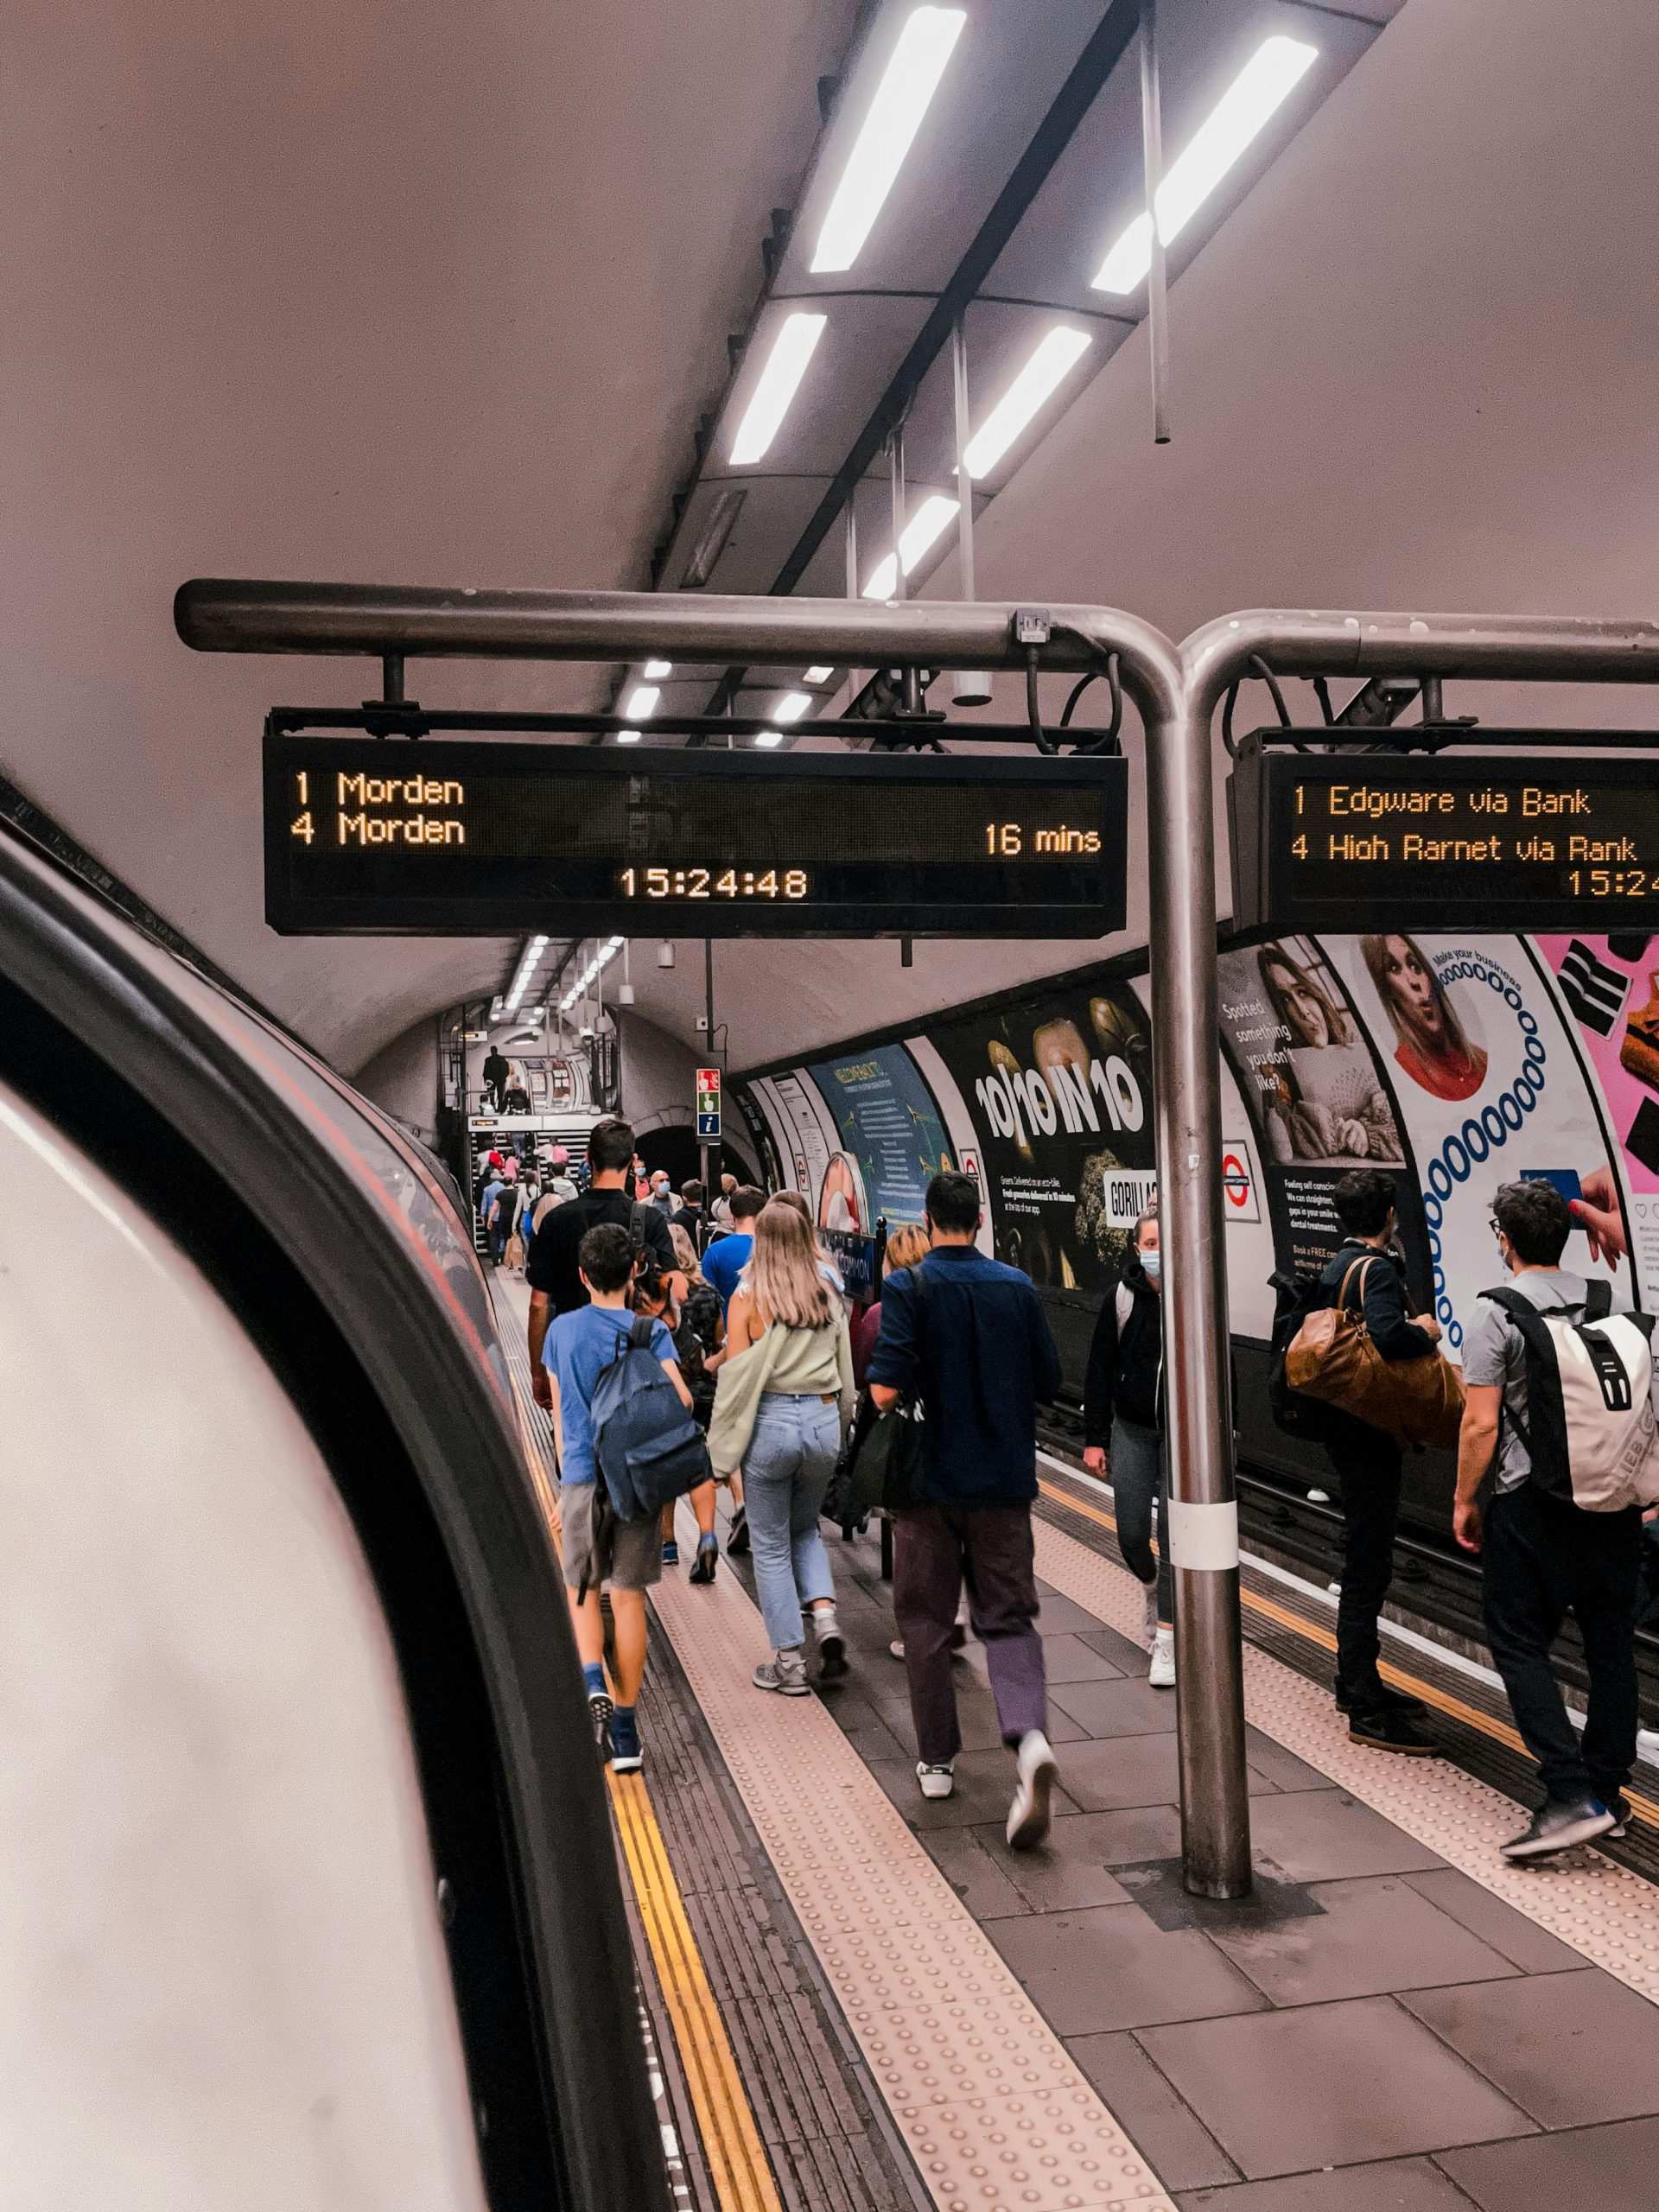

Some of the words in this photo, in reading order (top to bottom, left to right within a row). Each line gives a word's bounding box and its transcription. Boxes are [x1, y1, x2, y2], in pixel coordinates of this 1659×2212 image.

[296, 772, 308, 804] 1
[338, 772, 464, 804] Morden
[1295, 785, 1304, 815] 1
[1330, 785, 1455, 818] Edgware
[1469, 787, 1509, 813] via
[1522, 787, 1592, 817] Bank
[290, 811, 315, 845] 4
[338, 812, 465, 845] Morden
[986, 823, 1021, 855] 16
[1035, 824, 1102, 853] mins
[1292, 834, 1308, 860] 4
[1516, 836, 1555, 861] via
[621, 868, 807, 899] 15:24:48
[1433, 950, 1454, 967] Make
[1453, 949, 1473, 961] your
[1474, 950, 1522, 991] business
[1222, 999, 1266, 1023] Spotted
[1236, 1023, 1292, 1042] something
[1246, 1052, 1266, 1071] you
[1266, 1046, 1296, 1065] don't
[1255, 1072, 1281, 1090] like?
[1046, 1062, 1101, 1134] IN
[1090, 1054, 1144, 1133] 10
[1284, 1179, 1303, 1192] Feeling
[1303, 1180, 1313, 1190] self
[1286, 1192, 1296, 1202] We
[1288, 1207, 1301, 1217] gaps
[1301, 1206, 1307, 1216] in
[1306, 1209, 1319, 1218] your
[1319, 1209, 1333, 1218] smile
[1290, 1219, 1307, 1230] dental
[1293, 1244, 1306, 1255] Book
[1310, 1247, 1327, 1258] FREE
